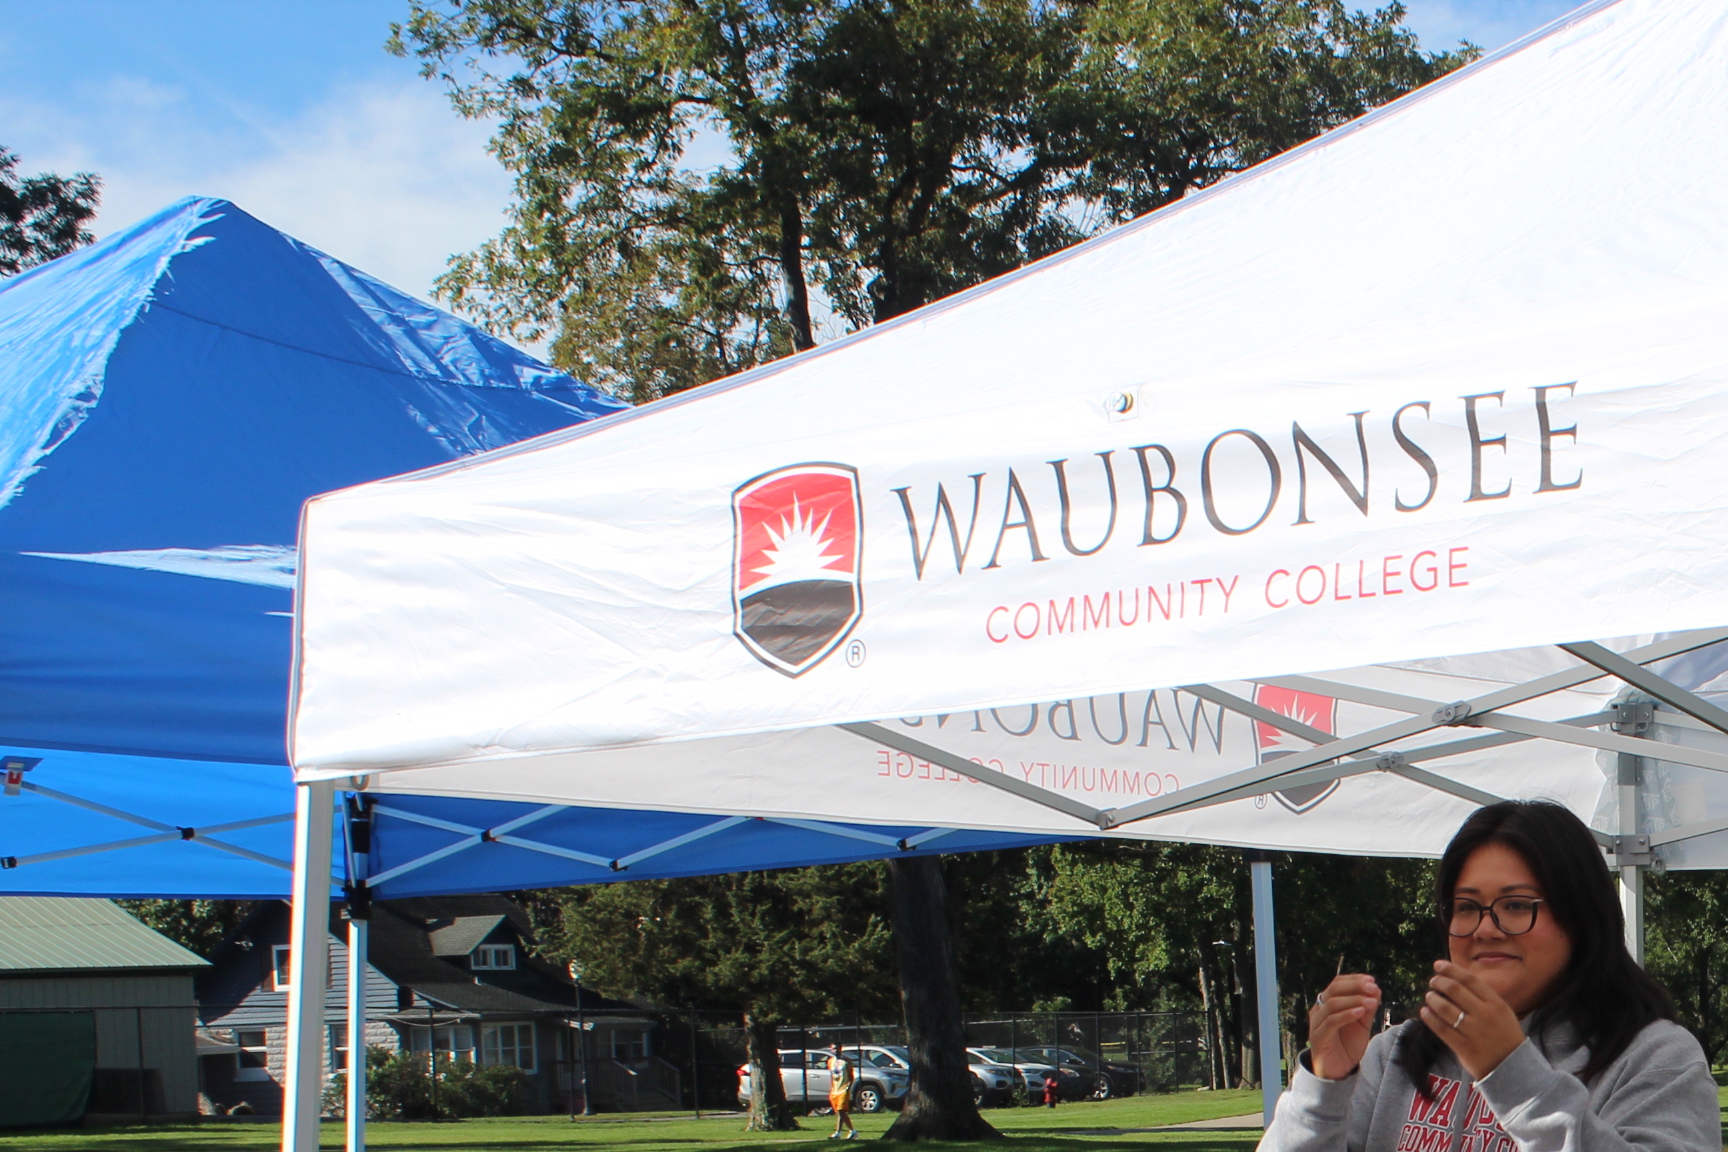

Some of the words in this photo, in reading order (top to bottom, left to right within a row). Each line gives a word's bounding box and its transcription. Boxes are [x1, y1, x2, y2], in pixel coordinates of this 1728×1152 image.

[890, 381, 1583, 582] WAUBONSEE
[986, 575, 1240, 644] COMMUNITY
[1265, 546, 1471, 609] COLLEGE
